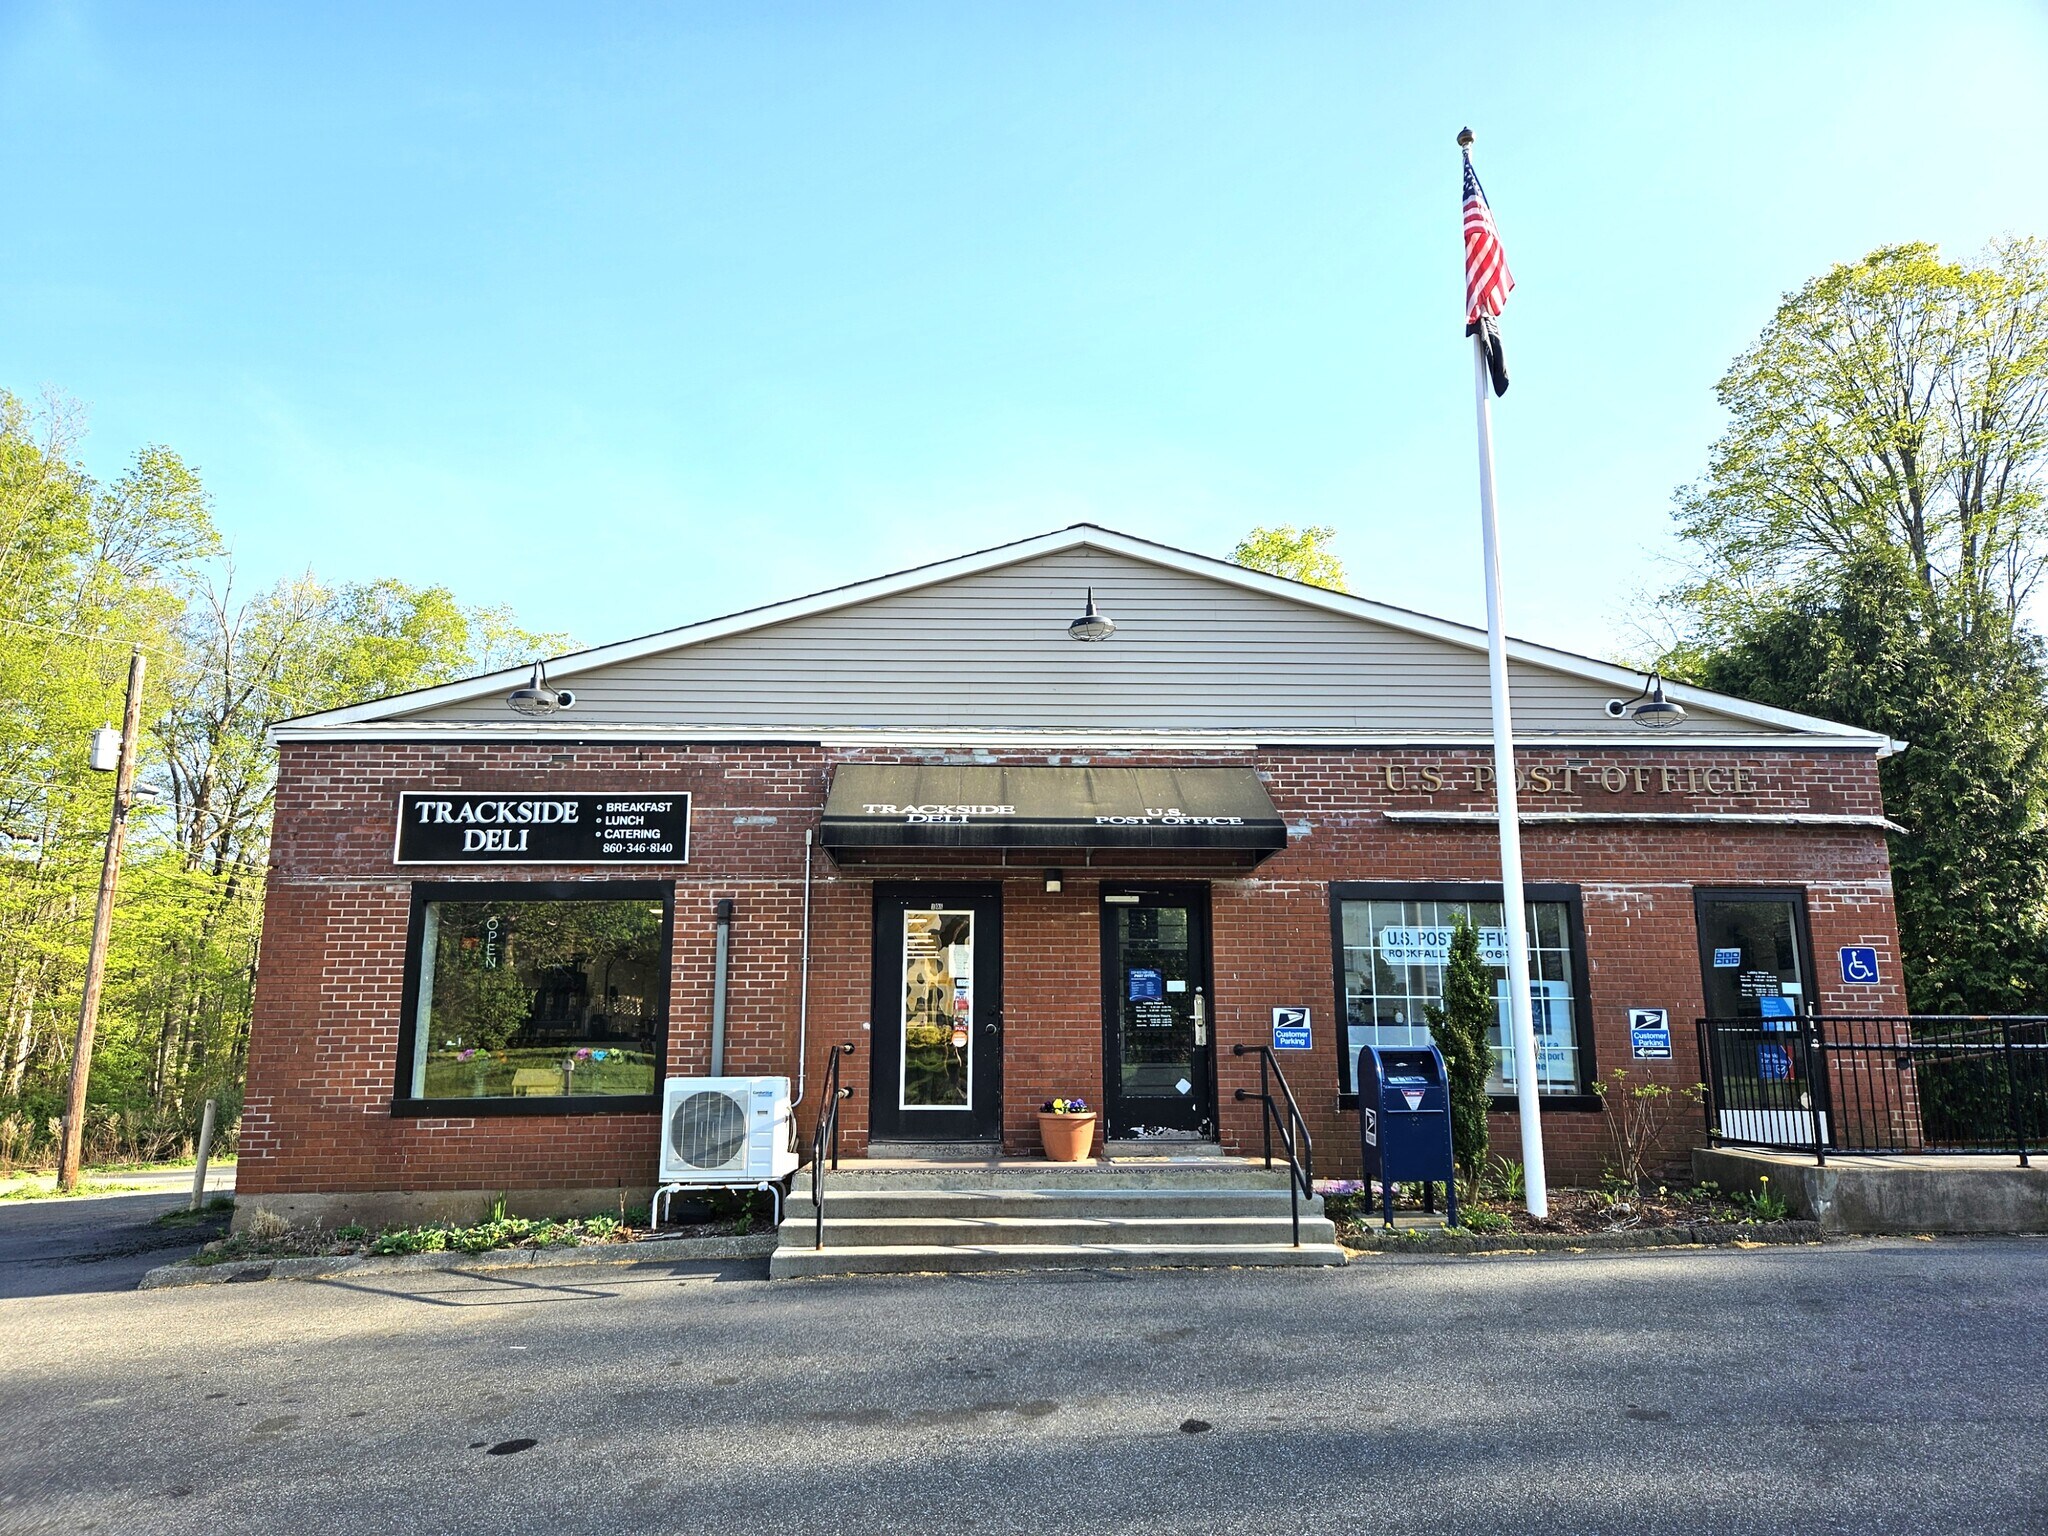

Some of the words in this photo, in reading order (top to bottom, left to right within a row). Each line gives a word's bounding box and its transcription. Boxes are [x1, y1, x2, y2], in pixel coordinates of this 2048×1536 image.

[1600, 766, 1754, 794] OFFICE
[605, 802, 673, 812] BREAKFAST
[862, 804, 1017, 815] TRACKSIDE
[415, 801, 579, 824] TRACKSIDE
[1144, 808, 1187, 817] U.S.
[605, 815, 645, 826] LUNCH
[906, 814, 970, 824] DELI
[1095, 816, 1152, 826] POST
[1161, 816, 1244, 826] OFFICE
[604, 829, 661, 839] CATERING
[462, 829, 528, 852] DELI
[486, 918, 499, 968] OPEN
[1389, 949, 1446, 958] ROCKFALL
[1275, 1030, 1309, 1038] Customer
[1280, 1038, 1306, 1046] Parking
